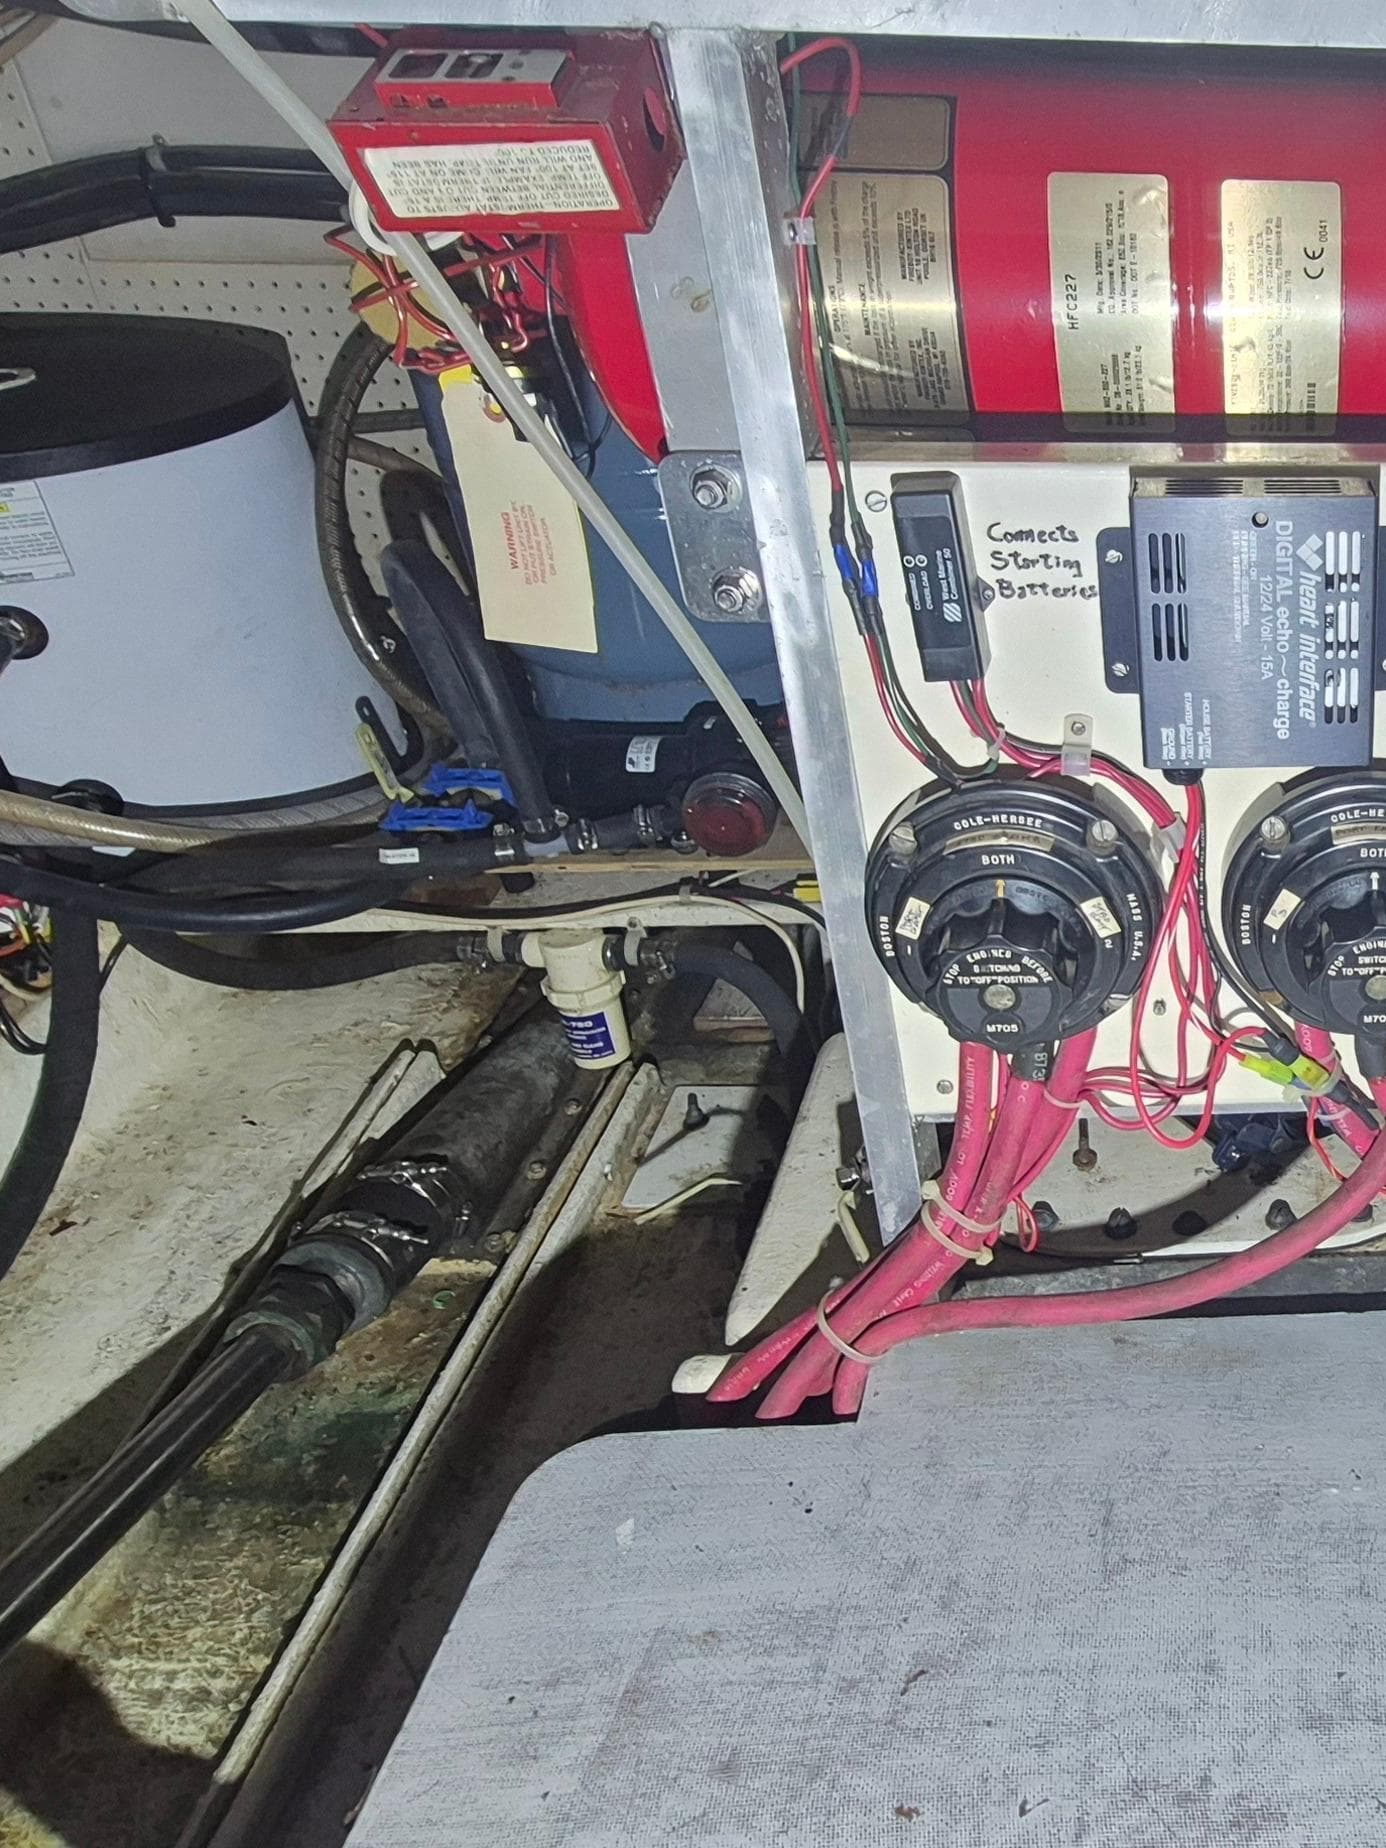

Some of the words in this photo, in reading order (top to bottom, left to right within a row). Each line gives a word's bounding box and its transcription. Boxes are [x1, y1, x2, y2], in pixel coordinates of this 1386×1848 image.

[1319, 219, 1328, 243] 0041
[1064, 273, 1079, 330] HFC227
[942, 547, 952, 559] 50
[990, 550, 1083, 578] Starting
[1275, 520, 1293, 603] DIGITAL
[1260, 575, 1273, 612] 12/24
[1299, 570, 1322, 628] heart
[1260, 615, 1273, 642] Volt
[1260, 654, 1273, 680] 15A
[1299, 633, 1321, 722] interface
[1187, 726, 1195, 760] BATTERY
[1203, 726, 1212, 760] BATTERY
[953, 813, 1044, 830] COLE-HERSEE
[981, 854, 1015, 865] BOTH
[1103, 938, 1113, 949] 2
[997, 975, 1039, 985] POSITION
[1342, 967, 1354, 976] TO
[986, 1024, 1019, 1033] M705
